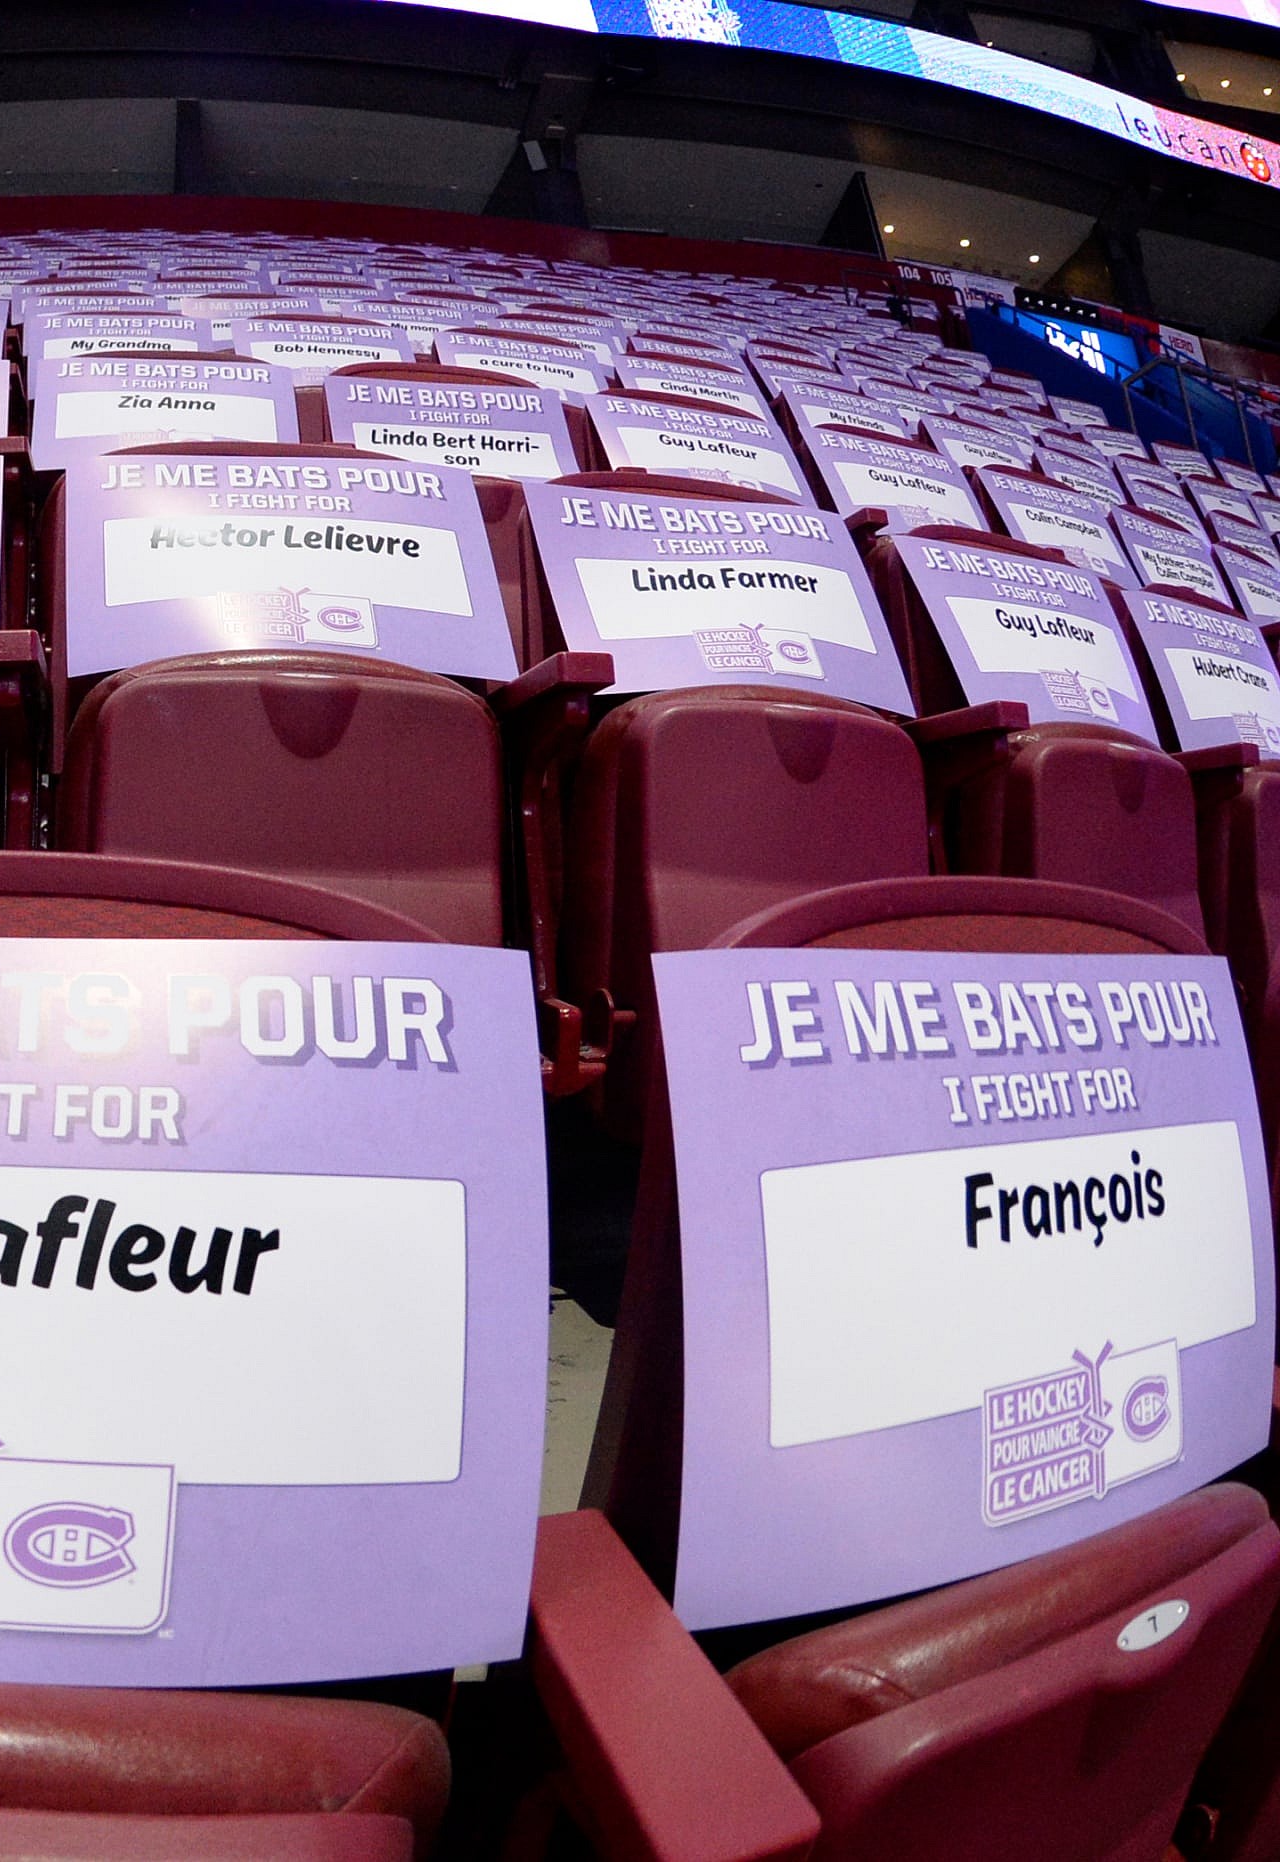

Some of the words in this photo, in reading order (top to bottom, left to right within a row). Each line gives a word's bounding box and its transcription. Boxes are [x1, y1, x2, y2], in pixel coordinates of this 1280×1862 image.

[1116, 102, 1237, 167] leucan
[898, 265, 920, 280] 104
[930, 271, 953, 286] 105
[70, 339, 95, 350] My
[98, 339, 171, 351] Grandma
[274, 344, 304, 353] Bob
[307, 344, 381, 360] Hennessy
[480, 358, 488, 366] a
[526, 362, 542, 371] to
[543, 364, 574, 379] lung
[118, 395, 152, 409] Zia
[157, 396, 216, 411] Anna
[660, 381, 697, 395] Cindy
[699, 386, 740, 401] Martin
[829, 411, 846, 424] My
[371, 429, 428, 447] Linda
[432, 432, 477, 450] Bert
[480, 436, 540, 454] Harri-
[659, 434, 695, 451] Guy
[698, 440, 757, 460] Lafleur
[443, 453, 481, 467] son
[101, 464, 144, 490] JE
[154, 463, 217, 488] ME
[228, 465, 329, 493] BATS
[338, 467, 446, 500] POUR
[868, 469, 898, 487] Guy
[899, 475, 946, 495] Lafleur
[208, 493, 219, 508] I
[220, 493, 300, 512] FIGHT
[305, 496, 352, 513] FOR
[561, 497, 597, 527] JE
[600, 501, 657, 533] ME
[660, 506, 746, 538] BATS
[744, 511, 831, 543] POUR
[150, 522, 276, 550] Hector
[283, 524, 422, 560] Lelievre
[653, 538, 666, 555] I
[667, 538, 729, 556] FIGHT
[734, 539, 771, 556] FOR
[632, 567, 716, 593] Linda
[720, 567, 818, 594] Farmer
[995, 607, 1037, 639] Guy
[1037, 617, 1097, 645] Lafleur
[1192, 656, 1237, 680] Hubert
[166, 974, 453, 1067] POUR
[739, 981, 825, 1066] JE
[834, 981, 951, 1056] ME
[952, 981, 1100, 1051] BATS
[1097, 981, 1218, 1045] POUR
[942, 1076, 970, 1124] I
[970, 1070, 1076, 1121] FIGHT
[1078, 1066, 1138, 1112] FOR
[53, 1085, 185, 1144] FOR
[965, 1149, 1166, 1248] François
[992, 1394, 1015, 1428] LE
[1017, 1375, 1089, 1422] HOCKEY
[993, 1438, 1028, 1468] POUR
[1030, 1419, 1081, 1457] VAINCRE
[992, 1478, 1016, 1508] LE
[1018, 1456, 1091, 1502] CANCER
[1147, 1615, 1158, 1633] 7
